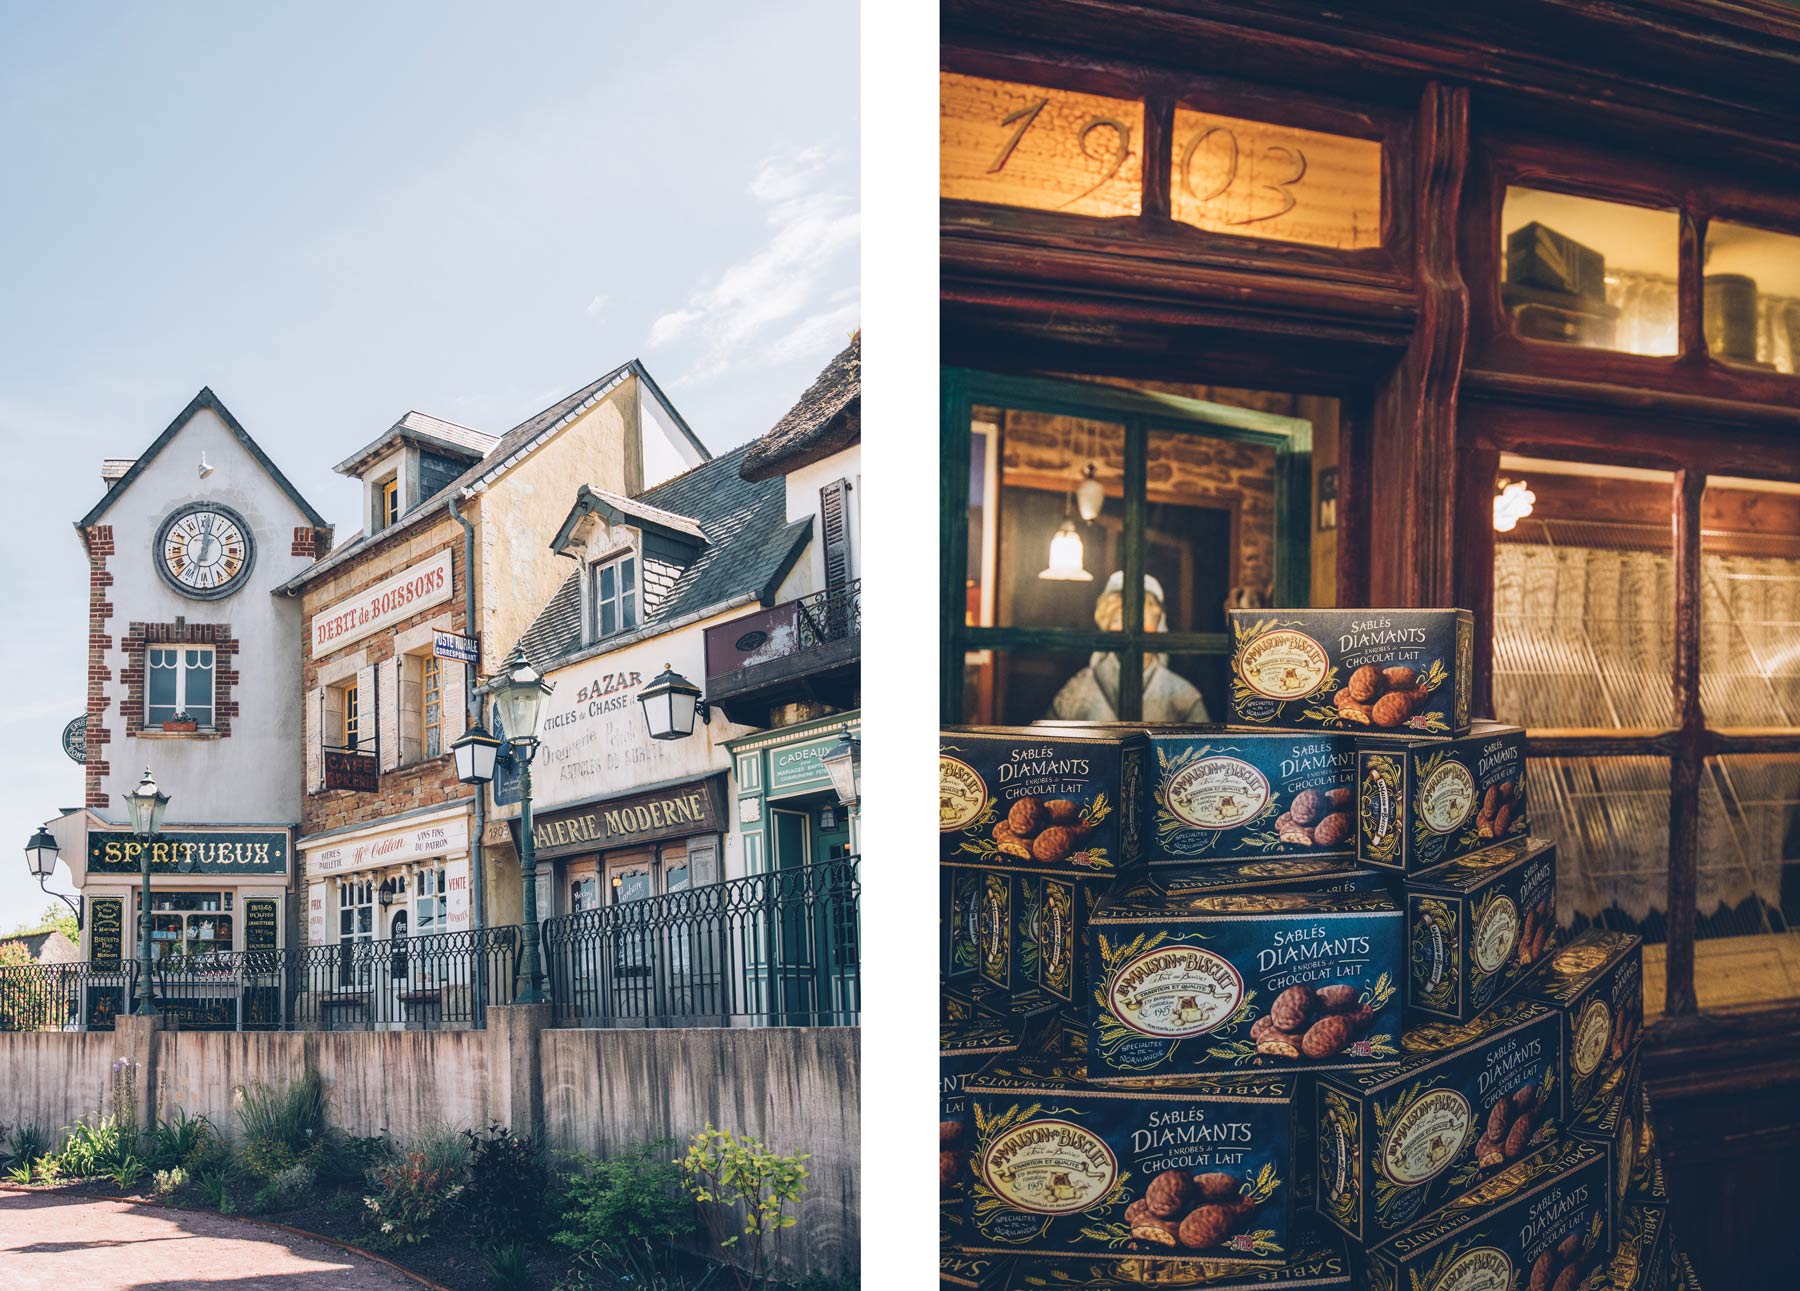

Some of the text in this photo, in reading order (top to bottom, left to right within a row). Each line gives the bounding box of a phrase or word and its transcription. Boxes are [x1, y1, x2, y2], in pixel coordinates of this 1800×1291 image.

[358, 607, 369, 626] de
[371, 566, 444, 619] BOISSONS
[1351, 616, 1391, 634] SABLÉS
[1288, 635, 1325, 665] BISCUIT
[1338, 628, 1426, 653] DIAMANTS
[1346, 651, 1419, 669] CHOCOLAT LAIT
[576, 671, 643, 704] BAZAR
[588, 696, 628, 718] CHASSE
[1011, 745, 1053, 762] SABLÉS
[1292, 741, 1332, 758] SABLÉS
[1478, 746, 1519, 776] DIAMANTS
[943, 761, 982, 794] BISCUIT
[998, 760, 1089, 783] DIAMANTS
[1176, 762, 1264, 793] MAISON BISCUIT
[1287, 775, 1336, 793] CHOCOLAT
[1005, 784, 1083, 800] CHOCOLAT LAIT
[604, 793, 705, 838] MODERNE
[371, 836, 406, 859] Odilon
[415, 838, 449, 851] DU PATRON
[416, 828, 445, 841] VINS FINS
[104, 841, 269, 864] SPRITUEUX
[448, 876, 466, 891] VENTE
[1273, 924, 1326, 947] SABLÉS
[1256, 936, 1370, 973] DIAMANTS
[1124, 953, 1177, 991] MAISON
[1184, 952, 1237, 990] BISCUIT
[1267, 964, 1363, 991] CHOCOLAT LAIT
[1139, 985, 1170, 998] TRADITION
[1486, 1038, 1517, 1068] SABLÉS
[1477, 1038, 1542, 1096] DIAMANTS
[1484, 1065, 1538, 1110] CHOCOLAT LAIT
[1149, 1106, 1205, 1128] SABLÉS
[1434, 1094, 1467, 1121] BISCUIT
[995, 1127, 1111, 1169] MAISON BISCUIT
[1130, 1123, 1252, 1153] DIAMANTS
[1012, 1160, 1043, 1170] TRADITION
[1142, 1153, 1244, 1174] CHOCOLAT LAIT
[1529, 1186, 1563, 1219] SABLÉS
[1519, 1184, 1589, 1249] DIAMANTS
[1527, 1211, 1586, 1264] CHOCOLAT LAIT
[1473, 1252, 1508, 1278] BISCUIT
